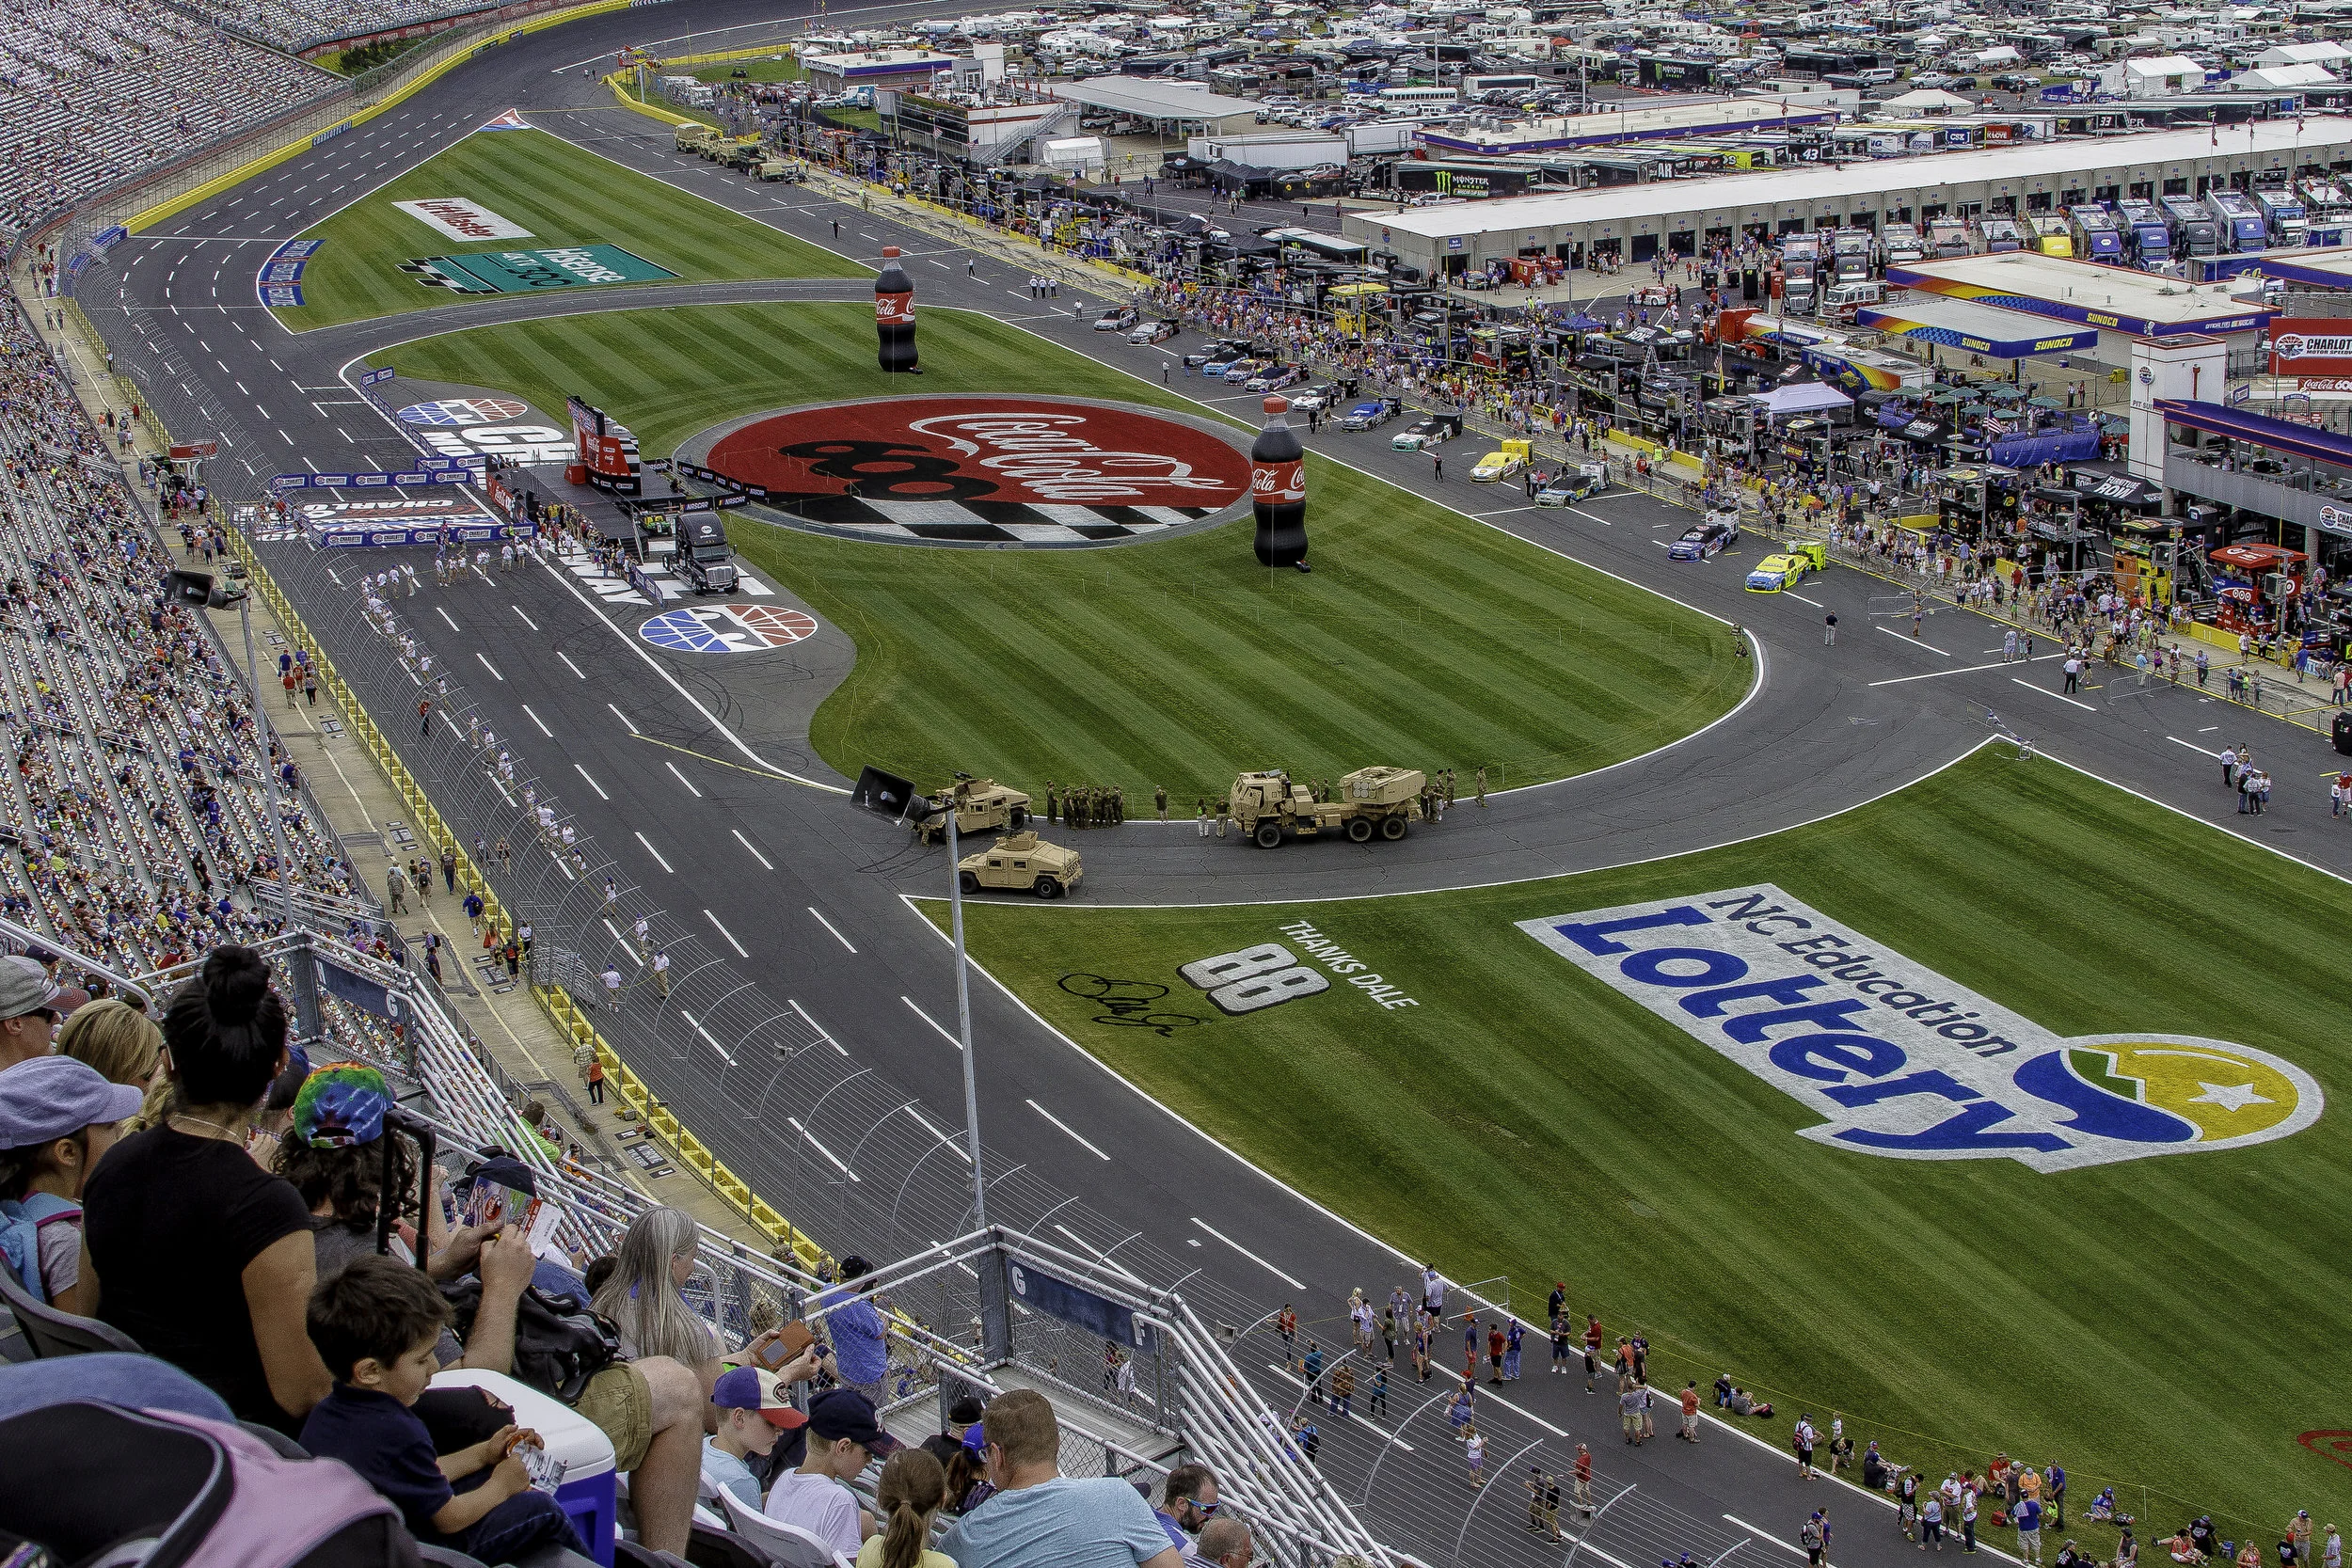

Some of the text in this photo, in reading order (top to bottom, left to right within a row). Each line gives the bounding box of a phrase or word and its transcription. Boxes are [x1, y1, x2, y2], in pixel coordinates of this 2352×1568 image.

[1662, 66, 1685, 75] MONSTER
[2099, 116, 2112, 127] 33
[313, 125, 342, 146] CHARLOTTE
[1803, 148, 1819, 160] 43
[1453, 176, 1489, 185] MONSTER
[534, 247, 628, 283] Hisense
[2087, 312, 2119, 326] SUNOCO
[1962, 337, 1991, 352] SUNOCO
[2034, 338, 2074, 351] SUNOCO
[2303, 378, 2334, 389] Coca-Cola
[2106, 475, 2141, 489] FURNITURE
[750, 488, 765, 497] NASCAR
[2093, 483, 2135, 499] ROW
[685, 501, 708, 511] NASCAR
[725, 496, 746, 506] NASCAR
[1279, 920, 1421, 1011] THANKS DALE
[1176, 942, 1331, 1017] 88
[1708, 893, 2019, 1058] NC Education
[385, 993, 397, 1018] G
[1552, 906, 2075, 1152] Lottery
[1011, 1266, 1026, 1295] G
